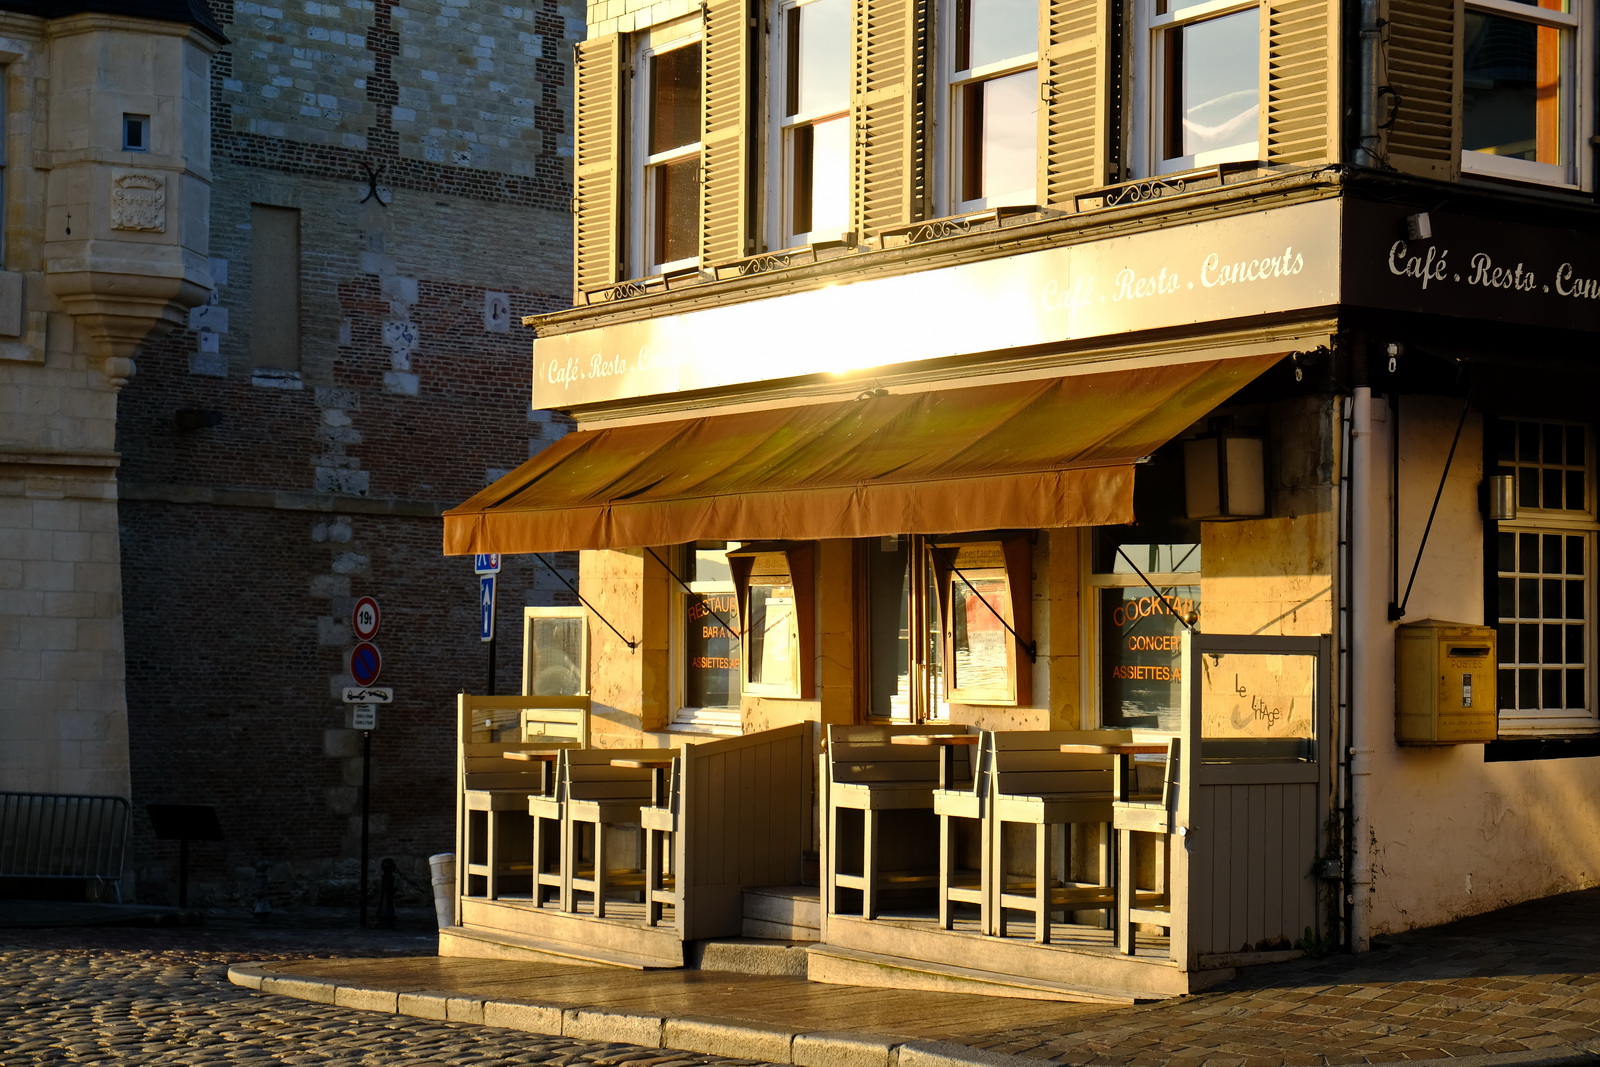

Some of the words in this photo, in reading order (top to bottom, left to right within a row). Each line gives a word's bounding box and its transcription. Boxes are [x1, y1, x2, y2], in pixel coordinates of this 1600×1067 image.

[1388, 239, 1449, 290] Café
[1467, 252, 1537, 292] Resto
[1555, 262, 1600, 300] Con
[1040, 276, 1094, 316] Café
[1113, 267, 1180, 303] Resto
[1200, 247, 1304, 288] Concerts
[547, 358, 579, 391] Café
[588, 353, 627, 380] Resto
[359, 611, 372, 625] 19t
[1113, 595, 1199, 627] COCKTAIL
[702, 626, 719, 638] BAR
[692, 656, 729, 669] ASSIETTES
[1451, 659, 1483, 669] POSTES
[1112, 665, 1170, 681] ASSIETTES
[1235, 673, 1247, 698] Le
